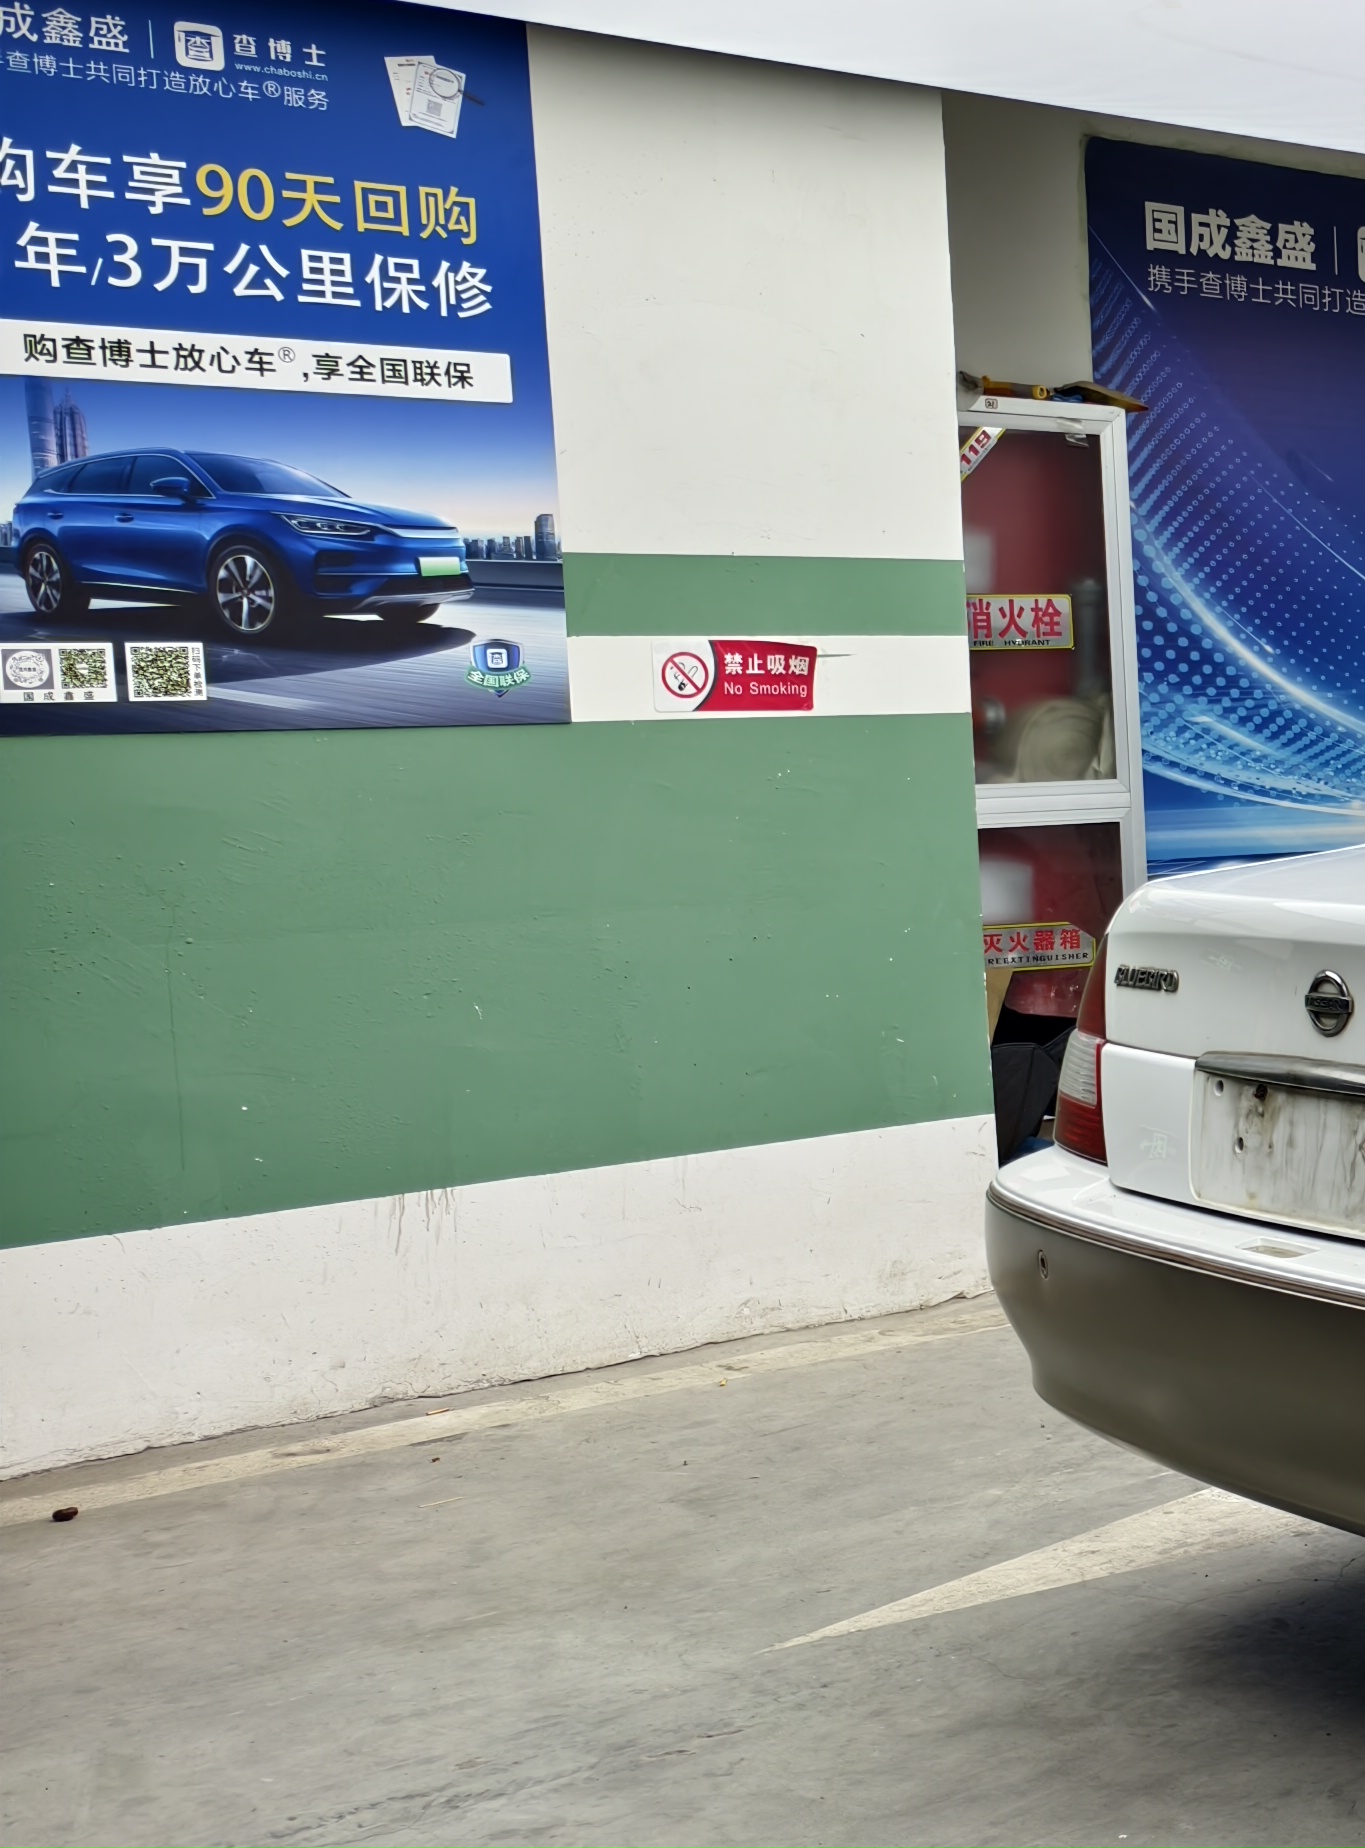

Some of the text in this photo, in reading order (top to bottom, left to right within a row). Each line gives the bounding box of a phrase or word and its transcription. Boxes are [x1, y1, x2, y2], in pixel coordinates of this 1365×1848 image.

[0, 2, 130, 53] 成鑫盛
[232, 34, 327, 66] 查博士
[0, 50, 329, 110] 查博士共同打造放心车®服务
[235, 62, 328, 81] www.chaboshi.cn
[1144, 201, 1316, 271] 国成鑫盛
[14, 222, 493, 318] 年/3万公里保修
[966, 598, 1063, 640] 消火栓
[467, 669, 530, 688] 全国联保
[724, 653, 810, 675] 禁止吸烟
[724, 681, 807, 697] No Smoking
[983, 928, 1081, 954] 灭火器箱
